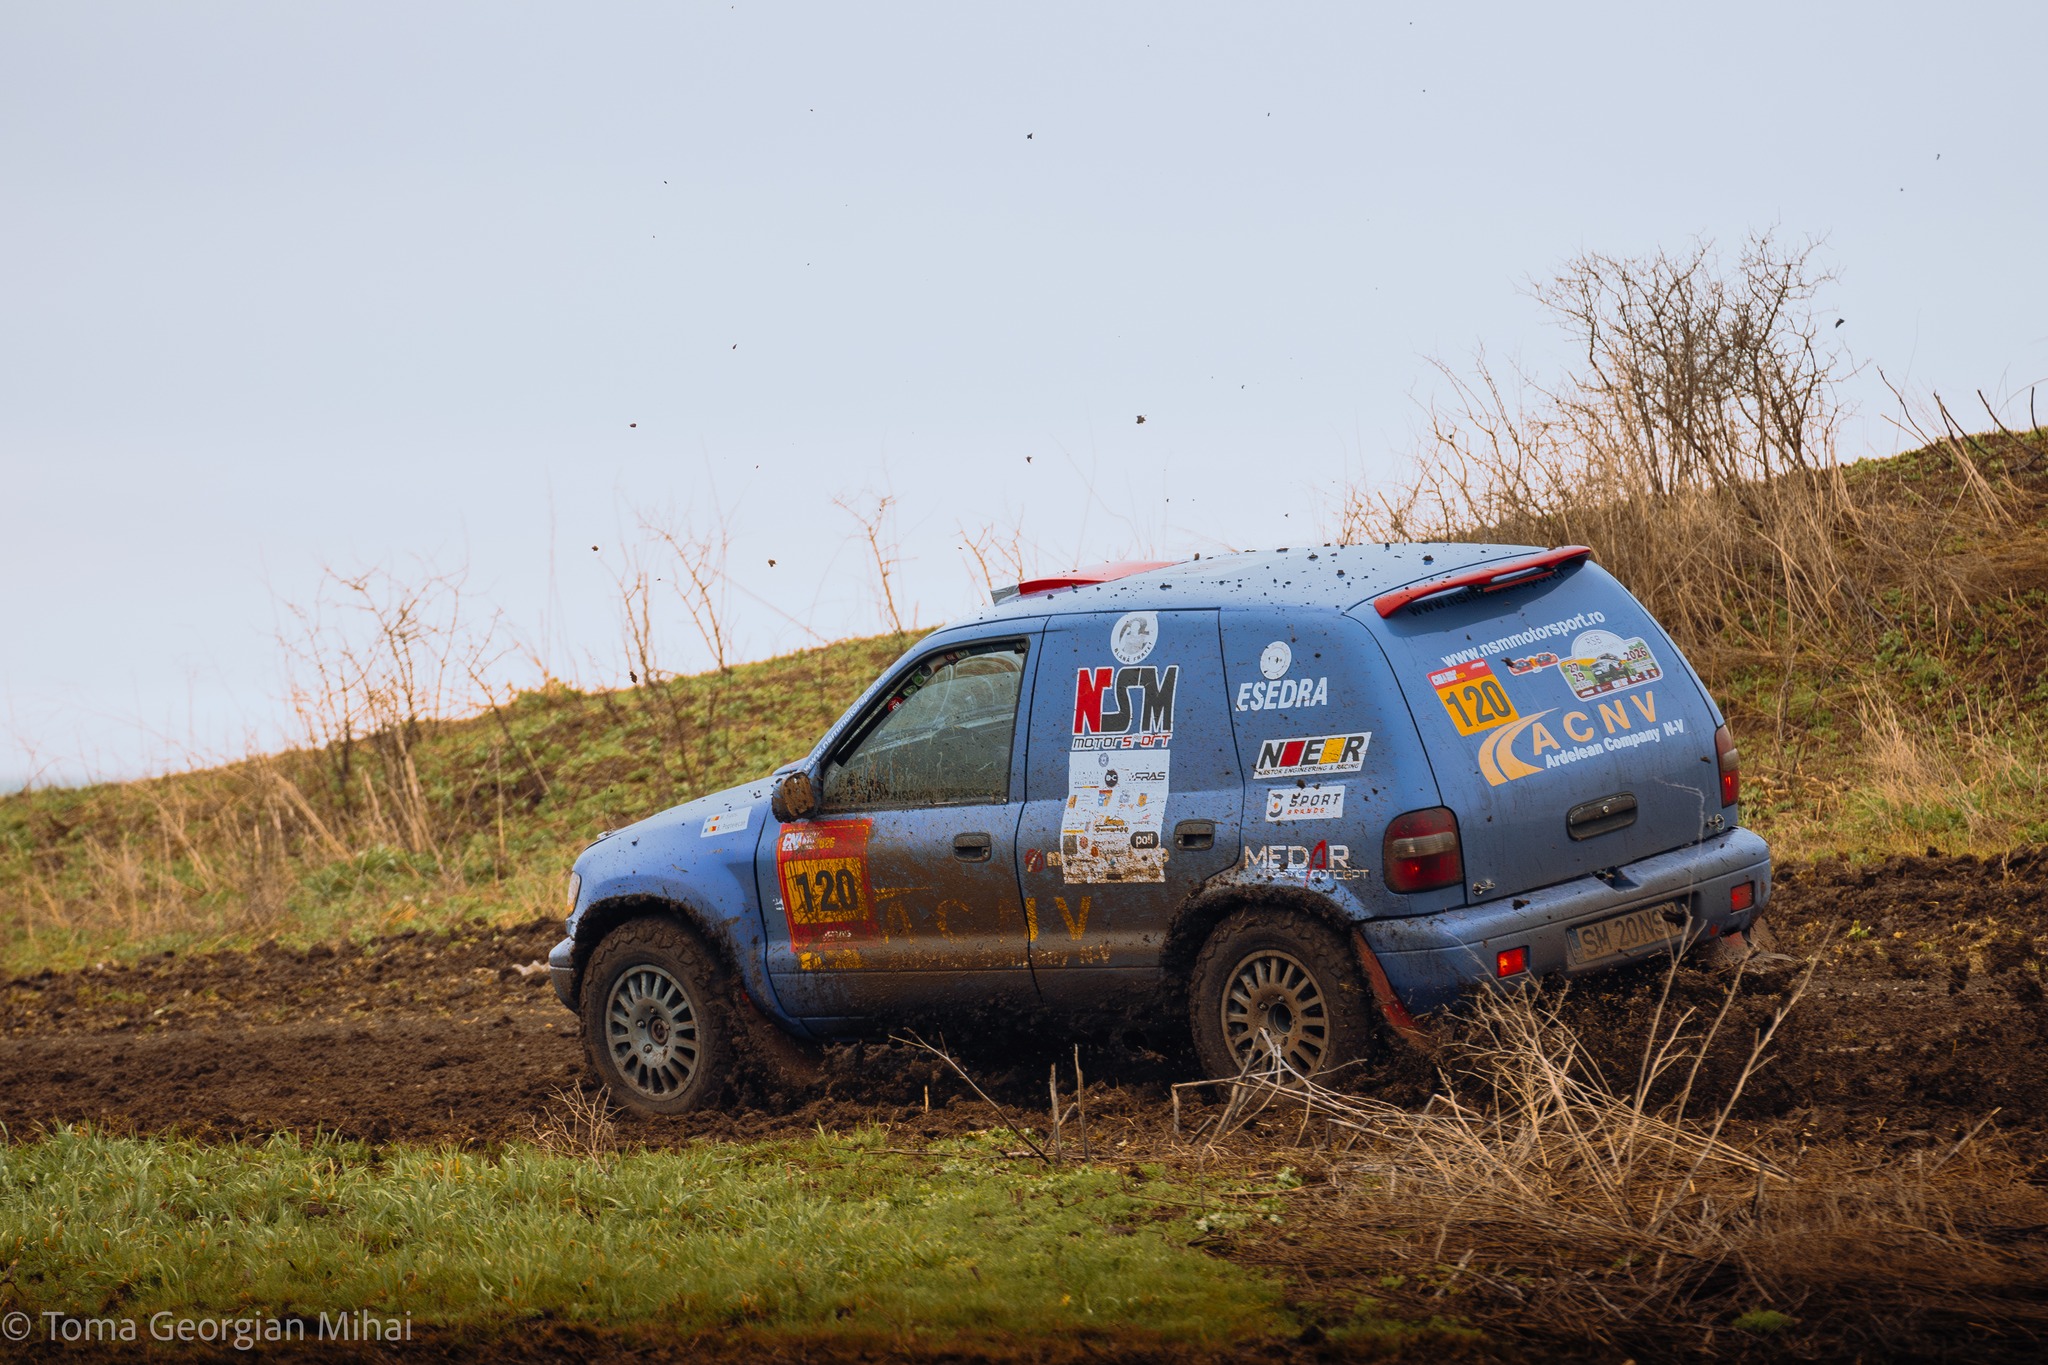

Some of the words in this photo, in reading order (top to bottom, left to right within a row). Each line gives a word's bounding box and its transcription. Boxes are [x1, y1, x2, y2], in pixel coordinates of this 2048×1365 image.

[1441, 611, 1606, 667] www.nsmmotorsport.ro
[1623, 647, 1648, 661] 2026
[1573, 672, 1585, 682] 29
[1072, 666, 1179, 735] NSM
[1236, 677, 1328, 712] ESEDRA
[1446, 681, 1511, 728] 120
[1545, 743, 1604, 768] Ardelean
[1603, 728, 1660, 752] Company
[1663, 719, 1684, 737] N-V
[1284, 765, 1327, 774] ENGINEERING
[1336, 763, 1360, 771] RACING
[1289, 793, 1341, 808] SPORT
[1244, 840, 1352, 873] MEDAR
[796, 868, 859, 914] 120
[1582, 925, 1612, 955] SM
